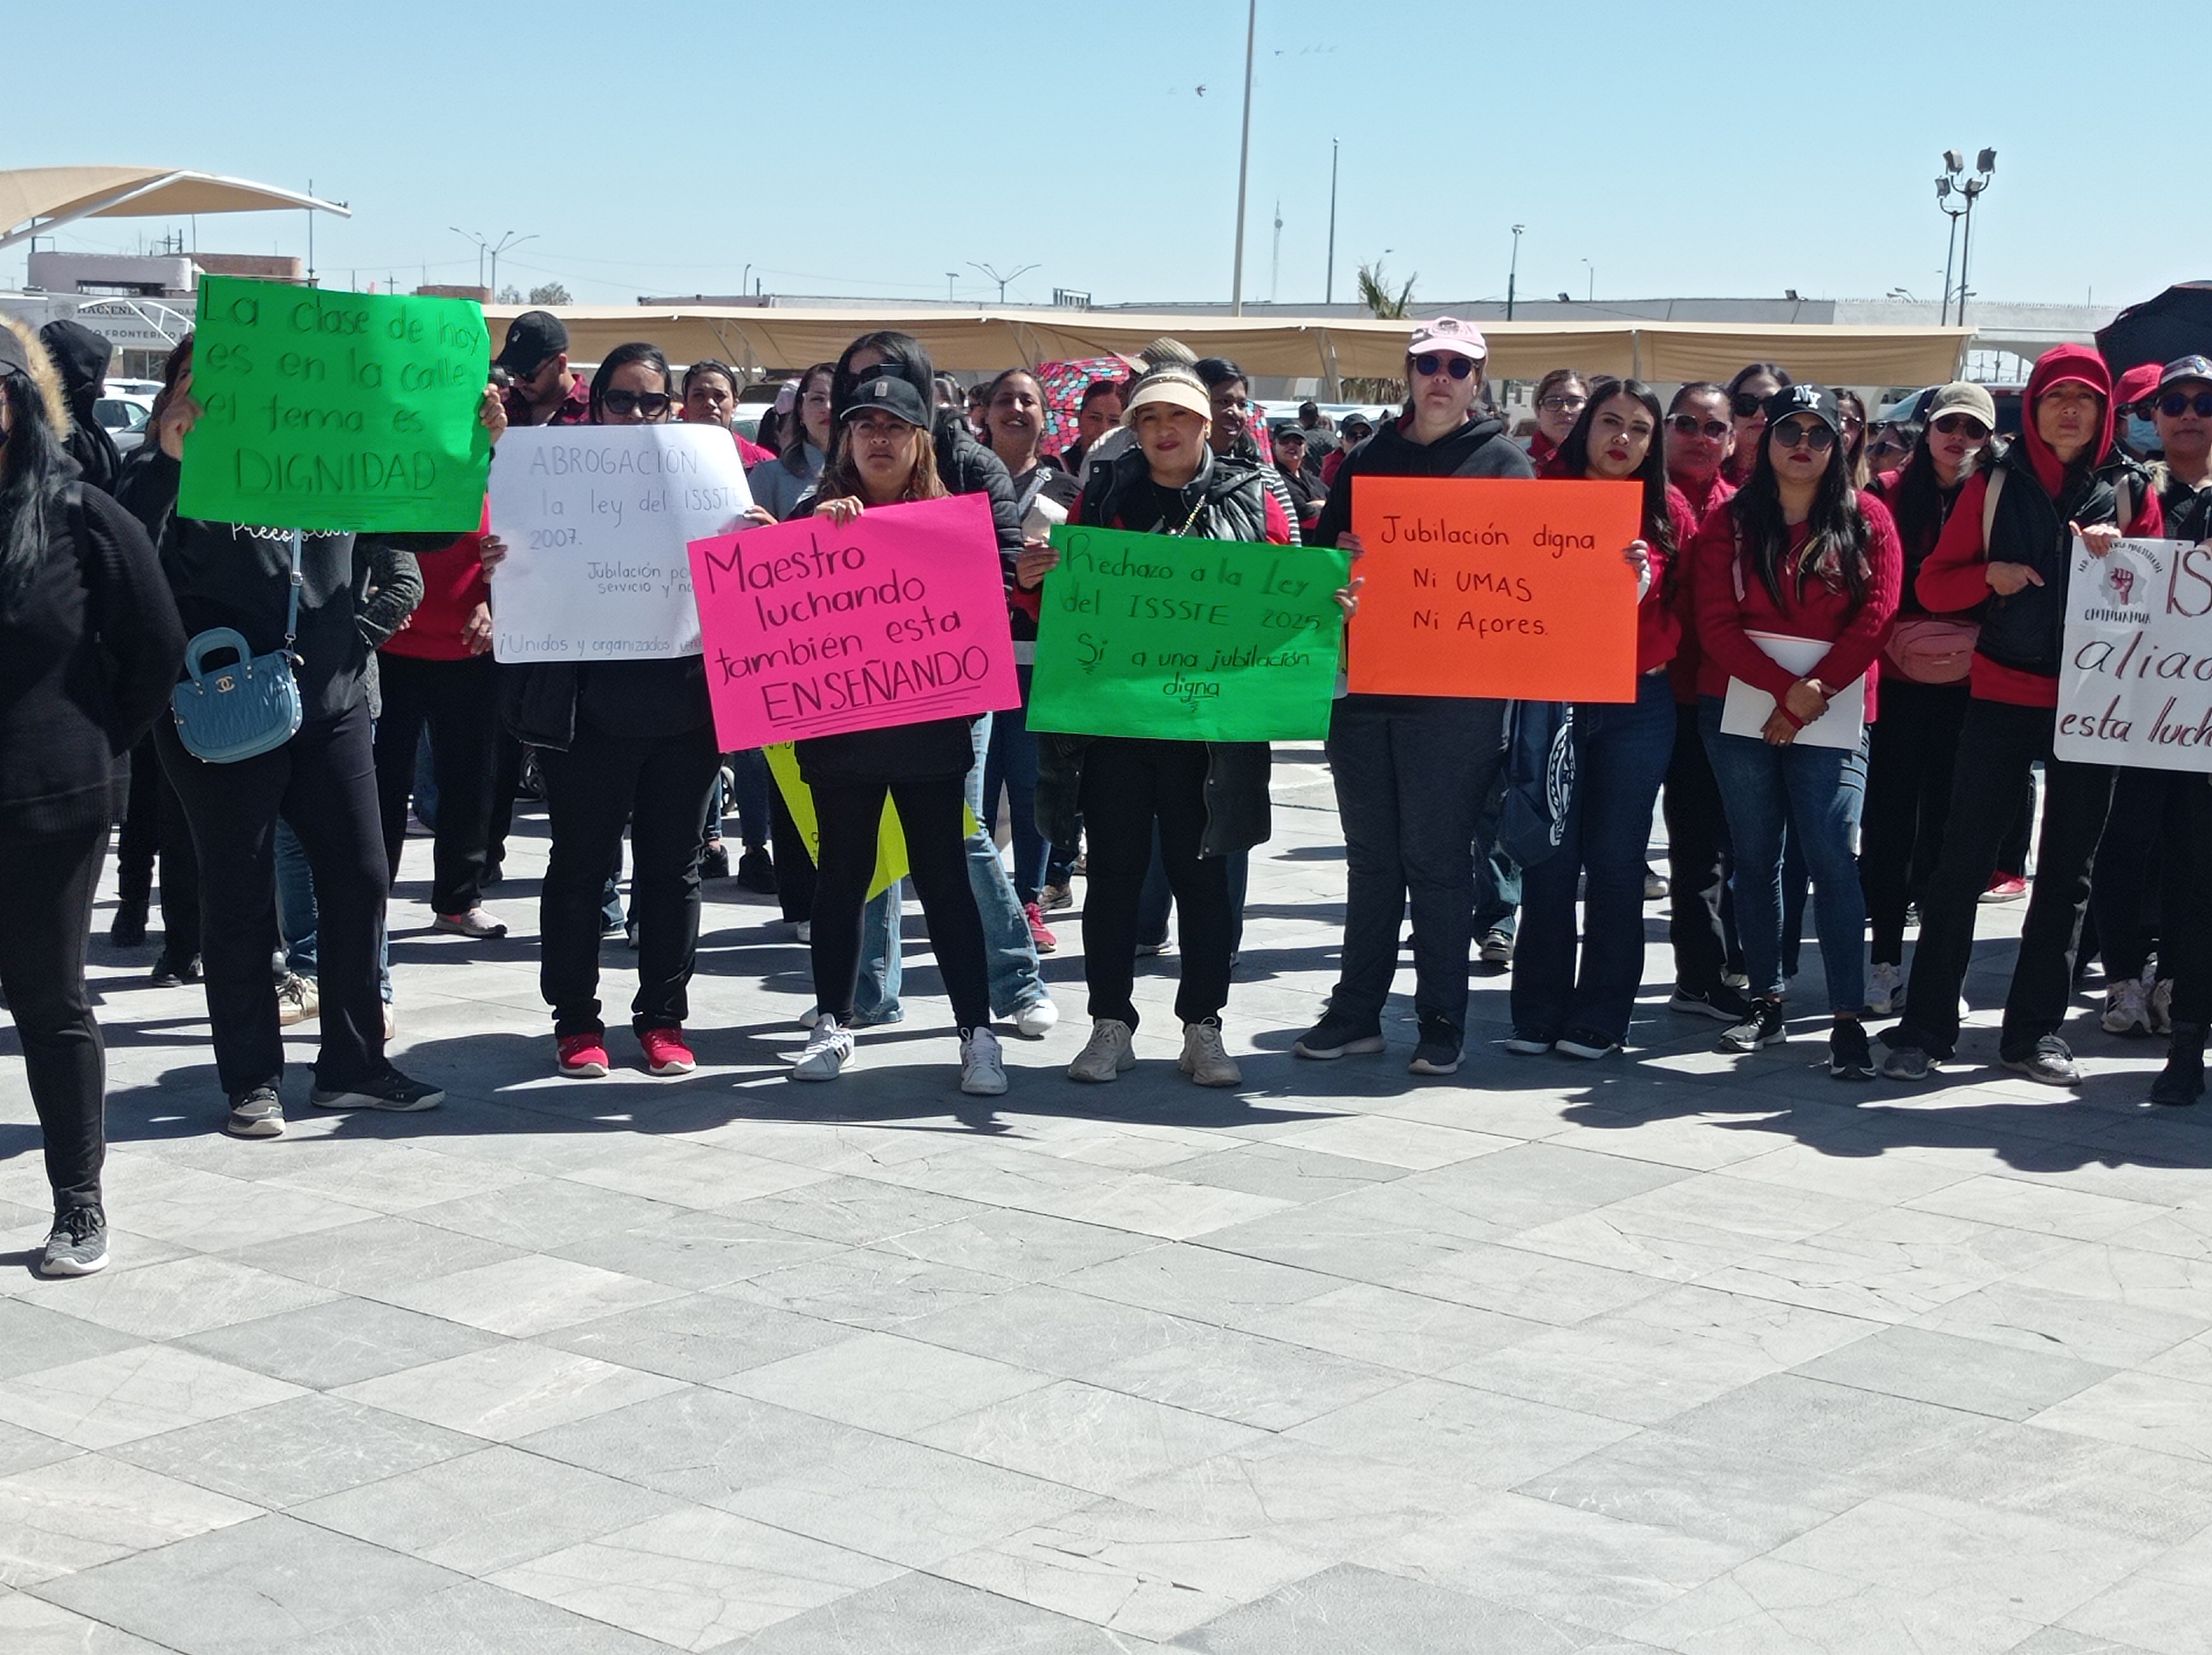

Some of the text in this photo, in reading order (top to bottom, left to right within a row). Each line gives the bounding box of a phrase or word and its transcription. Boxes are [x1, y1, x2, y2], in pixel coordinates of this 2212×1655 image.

[203, 280, 259, 327] La
[389, 305, 423, 343] de
[439, 311, 480, 356] hoy
[206, 342, 465, 393] es en la calle
[205, 392, 424, 435] el tema es
[1792, 384, 1822, 409] NY
[233, 447, 436, 494] DIGNIDAD
[529, 445, 697, 475] ABROGACIÓN
[542, 487, 744, 528] la ley del ISSSTE
[529, 528, 583, 550] 2007.
[1381, 516, 1595, 559] Jubilación digna
[587, 561, 661, 580] Jubilación
[703, 533, 865, 594] Maestro
[1065, 533, 1310, 597] Rechazo a la Ley
[1413, 568, 1532, 602] Ni UMAS
[598, 582, 651, 595] servicio
[661, 585, 670, 598] y
[755, 569, 925, 632] luchando
[1062, 577, 1321, 630] del ISSSTE 2025
[1413, 609, 1438, 629] Ni
[577, 639, 585, 657] y
[592, 636, 671, 655] organizados
[716, 605, 961, 686] también esta
[1131, 650, 1147, 667] a
[1158, 650, 1198, 668] una
[761, 645, 989, 721] ENSEÑANDO
[1163, 671, 1220, 703] digna
[2059, 694, 2133, 742] esta
